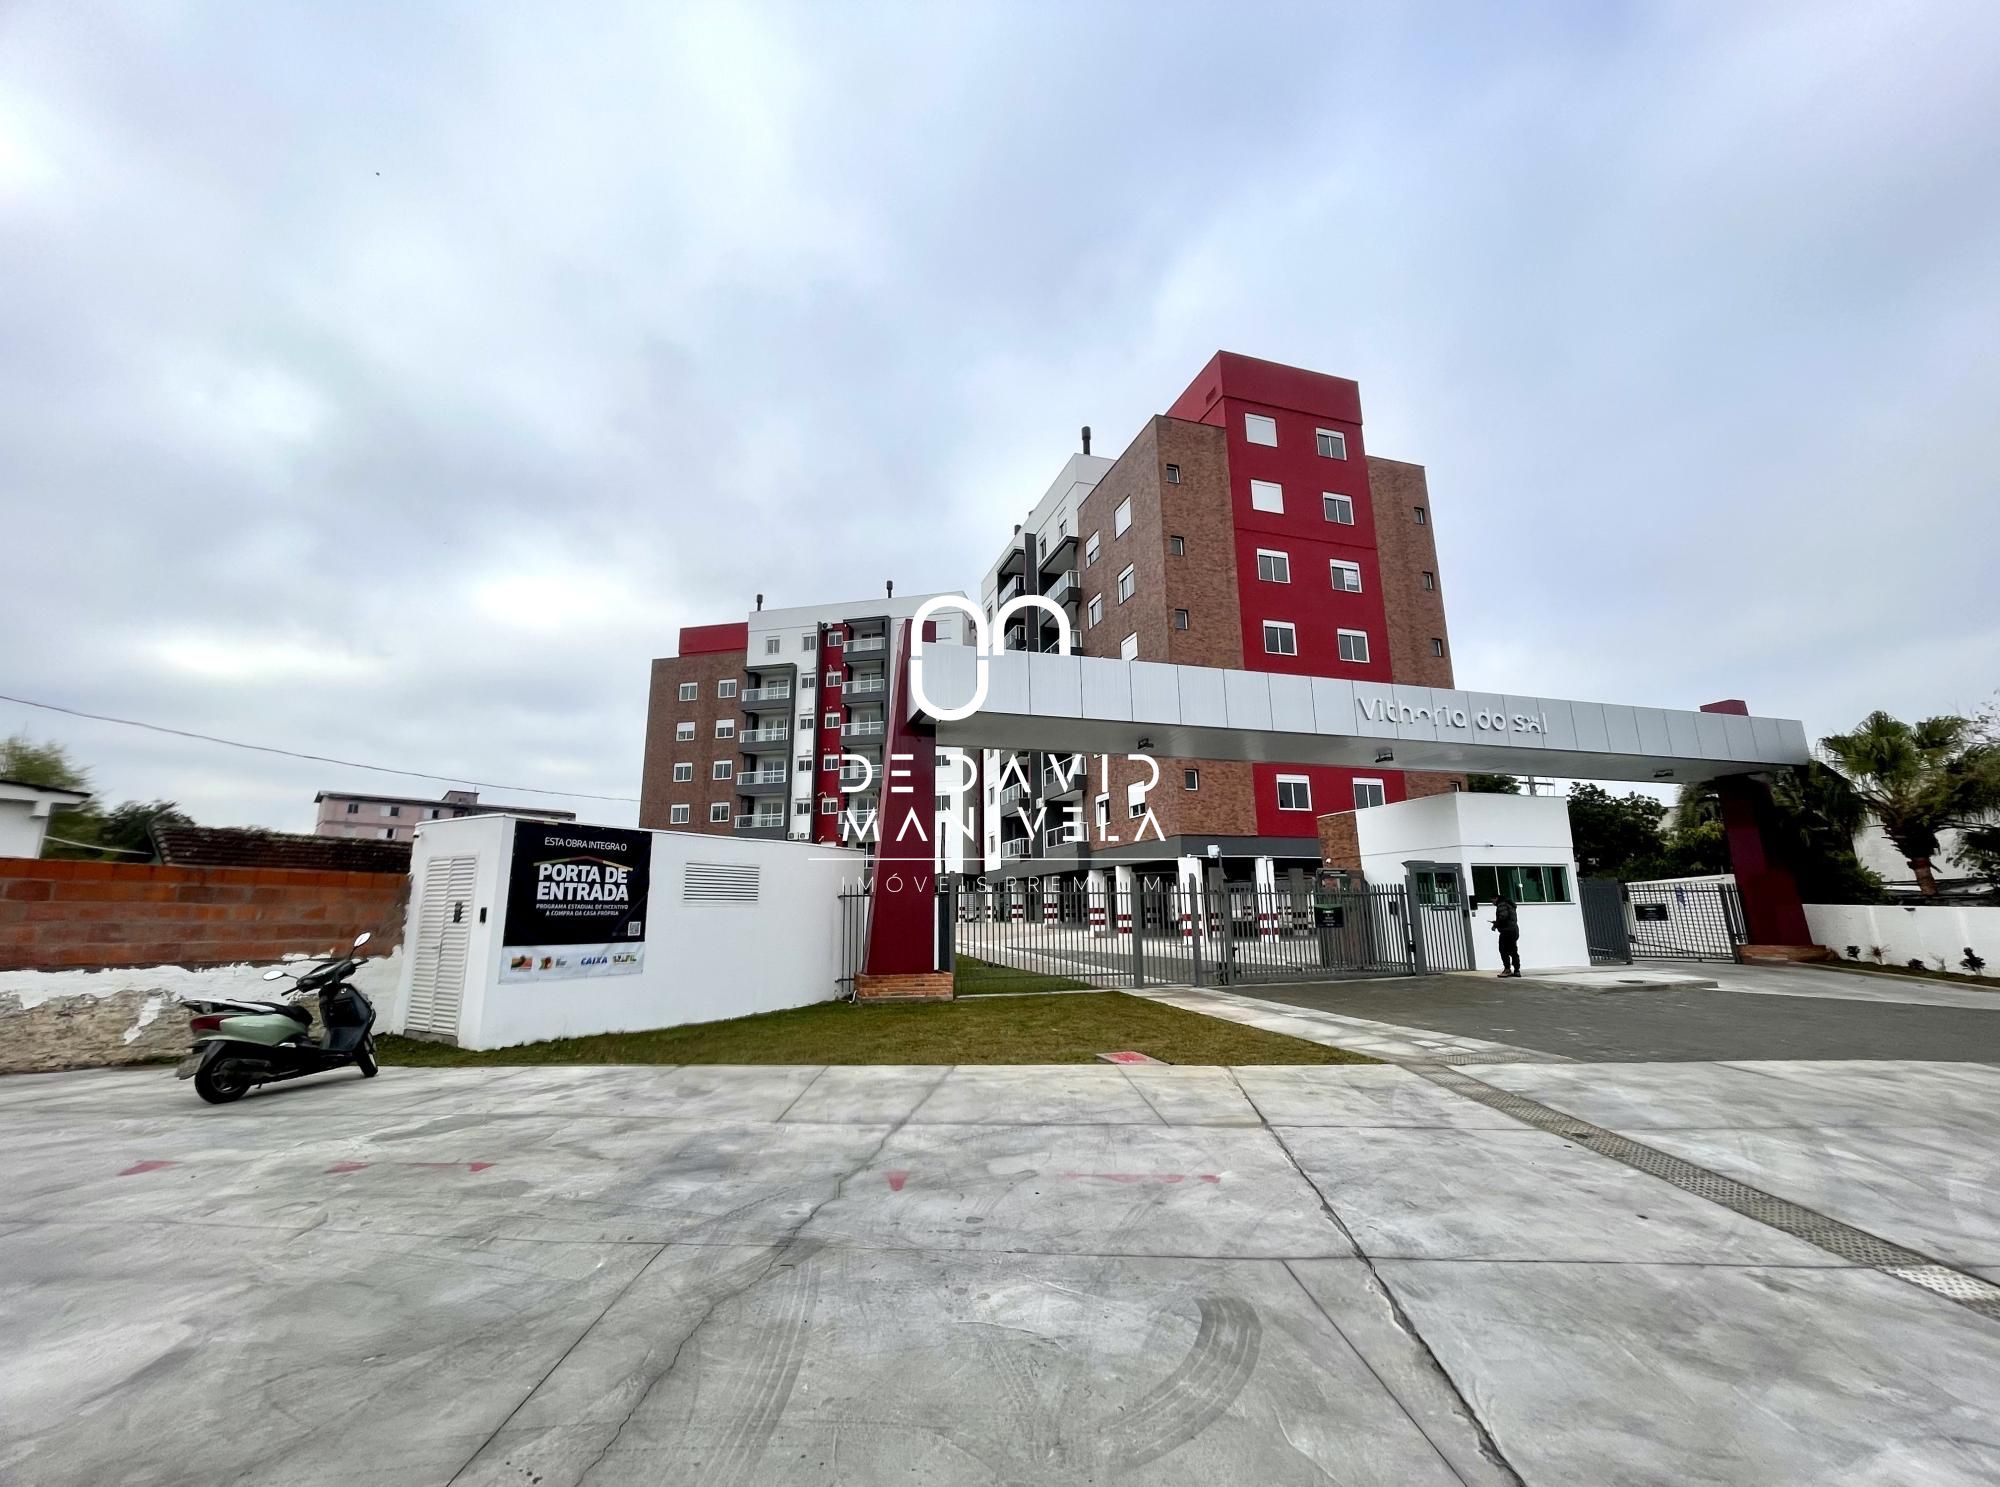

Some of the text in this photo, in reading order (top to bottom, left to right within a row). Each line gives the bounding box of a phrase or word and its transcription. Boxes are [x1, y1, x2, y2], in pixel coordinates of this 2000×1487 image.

[1477, 707, 1507, 731] do
[544, 837, 627, 852] ESTA OBRA INTEGRA O
[539, 863, 628, 884] PORTA DE
[537, 881, 629, 902] ENTRADA
[580, 956, 608, 966] CAIXA
